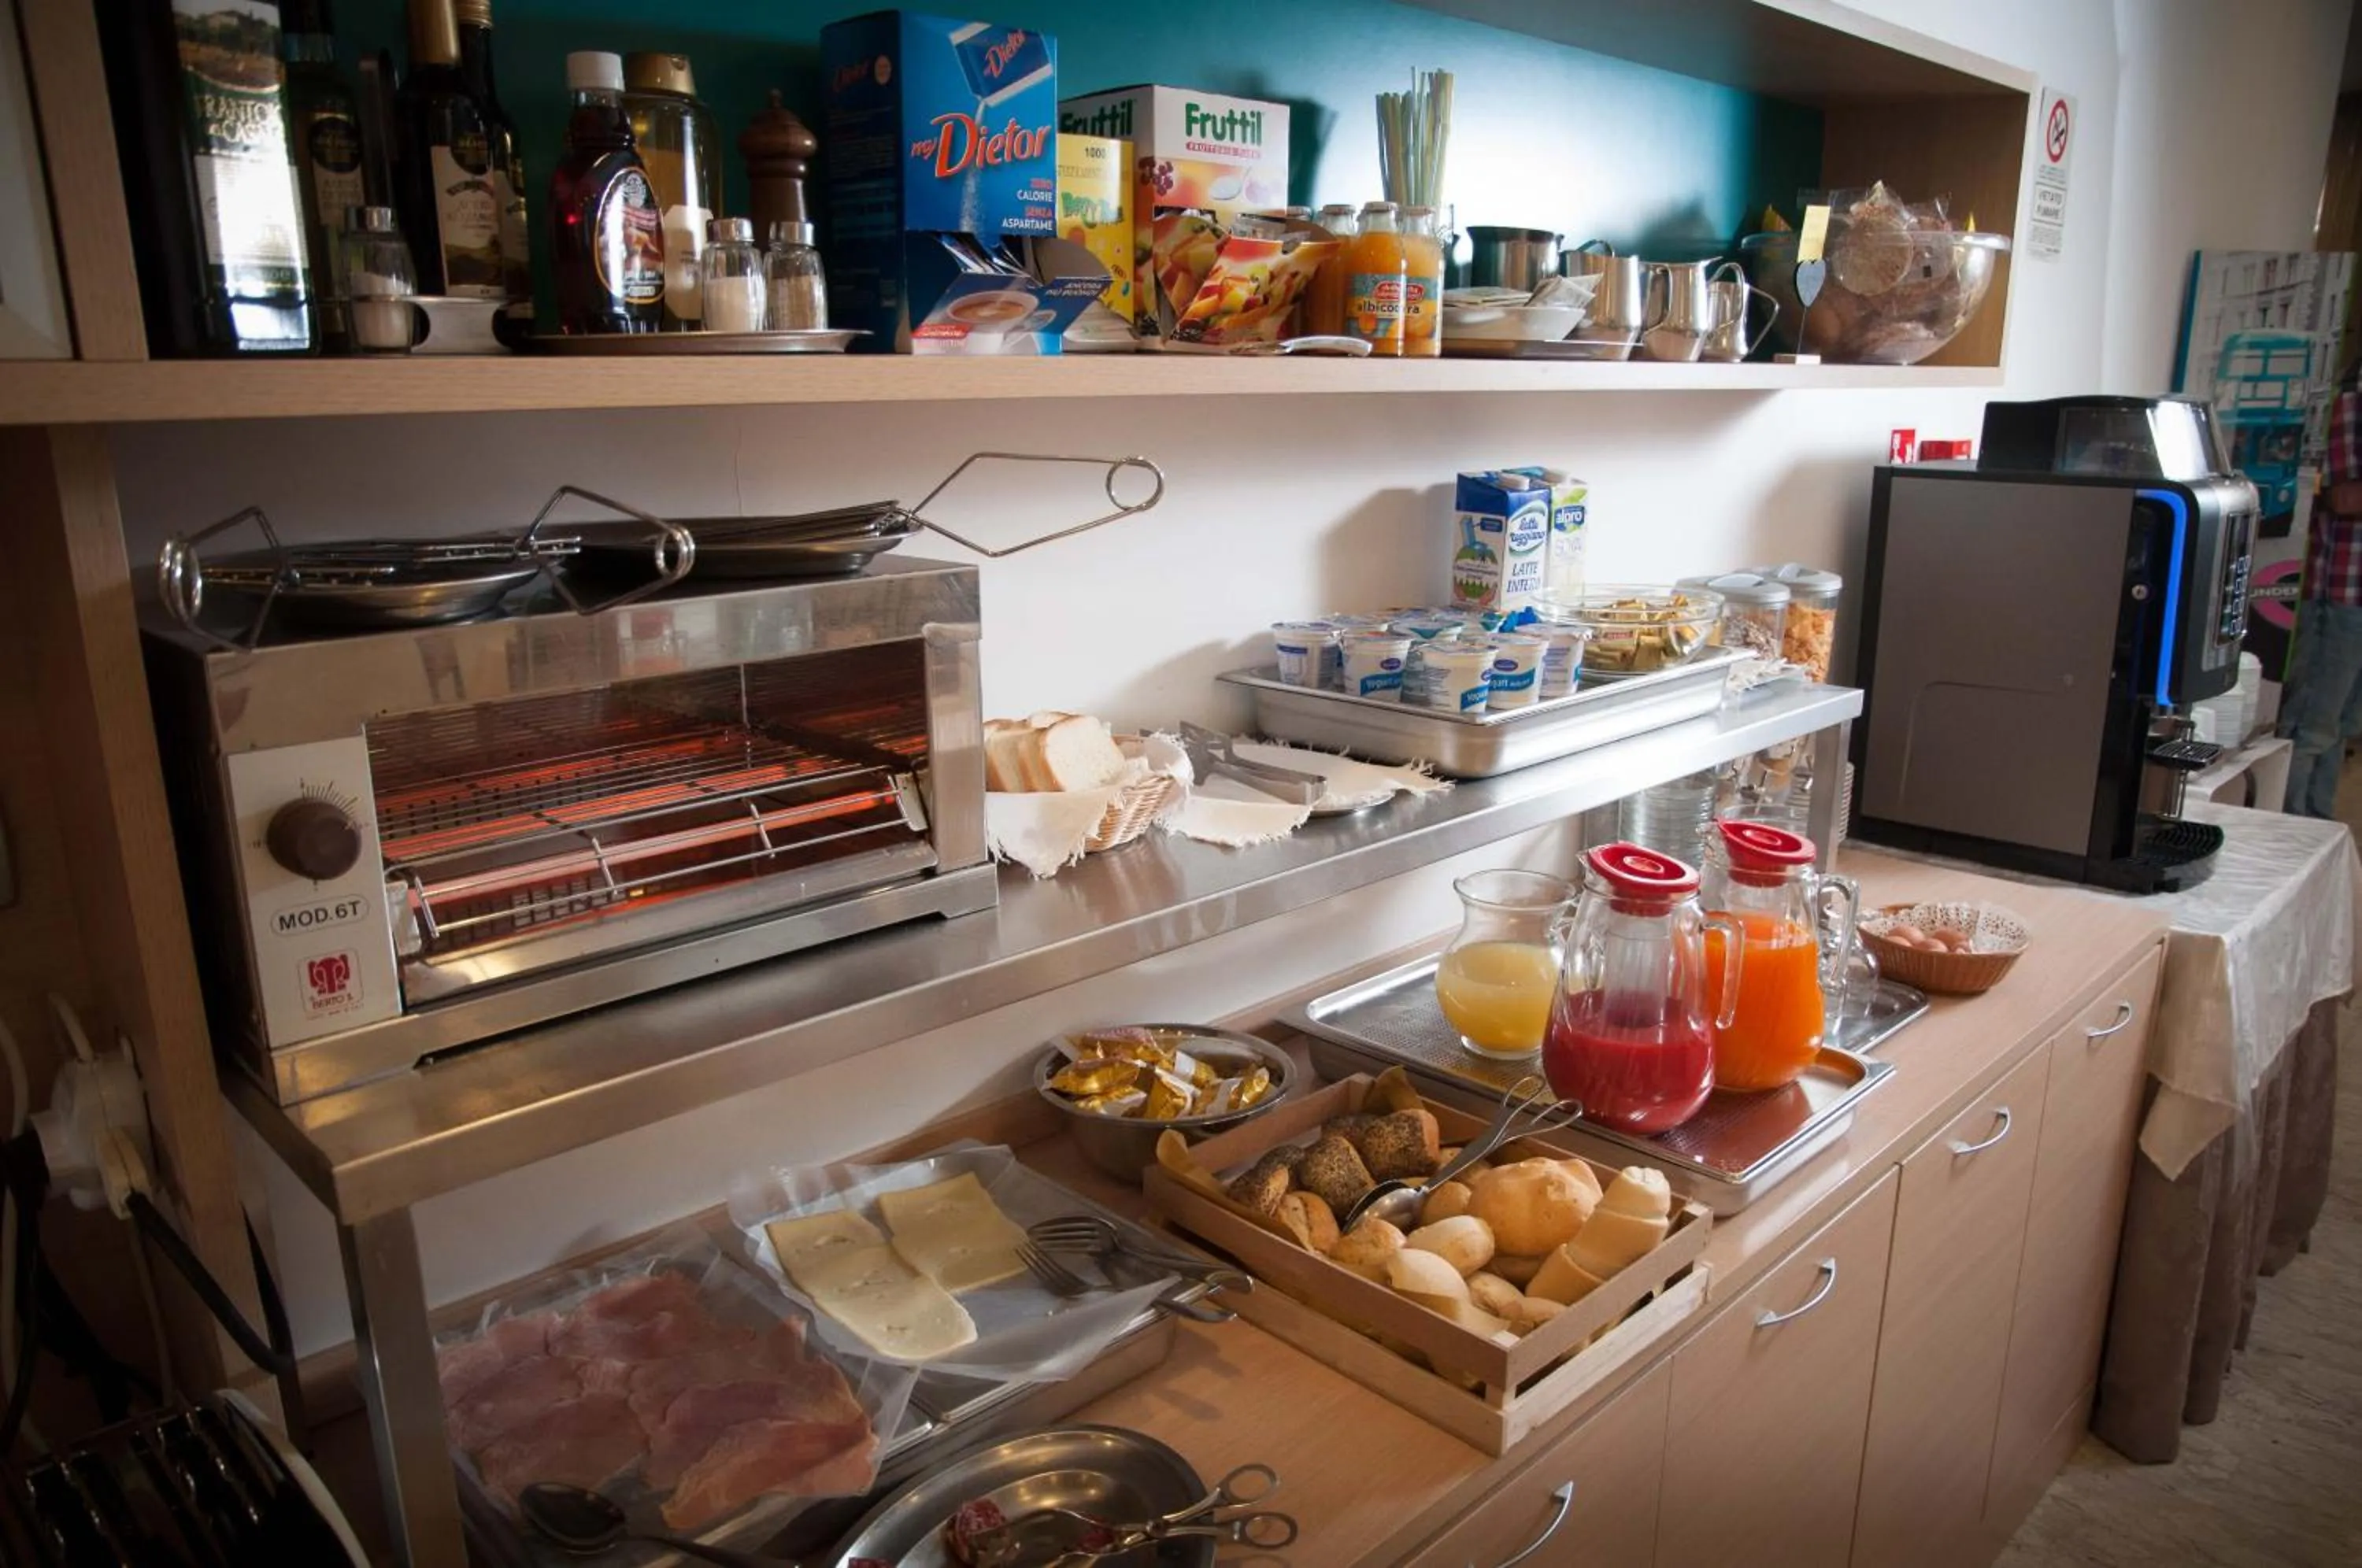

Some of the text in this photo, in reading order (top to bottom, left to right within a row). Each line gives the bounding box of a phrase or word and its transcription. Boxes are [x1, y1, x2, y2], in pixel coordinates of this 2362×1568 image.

[1185, 102, 1261, 146] Fruttil
[929, 113, 1053, 179] Dietor
[1016, 190, 1053, 203] CALORIE
[1001, 216, 1053, 231] ASPARTAME
[1512, 560, 1539, 577] LATTE
